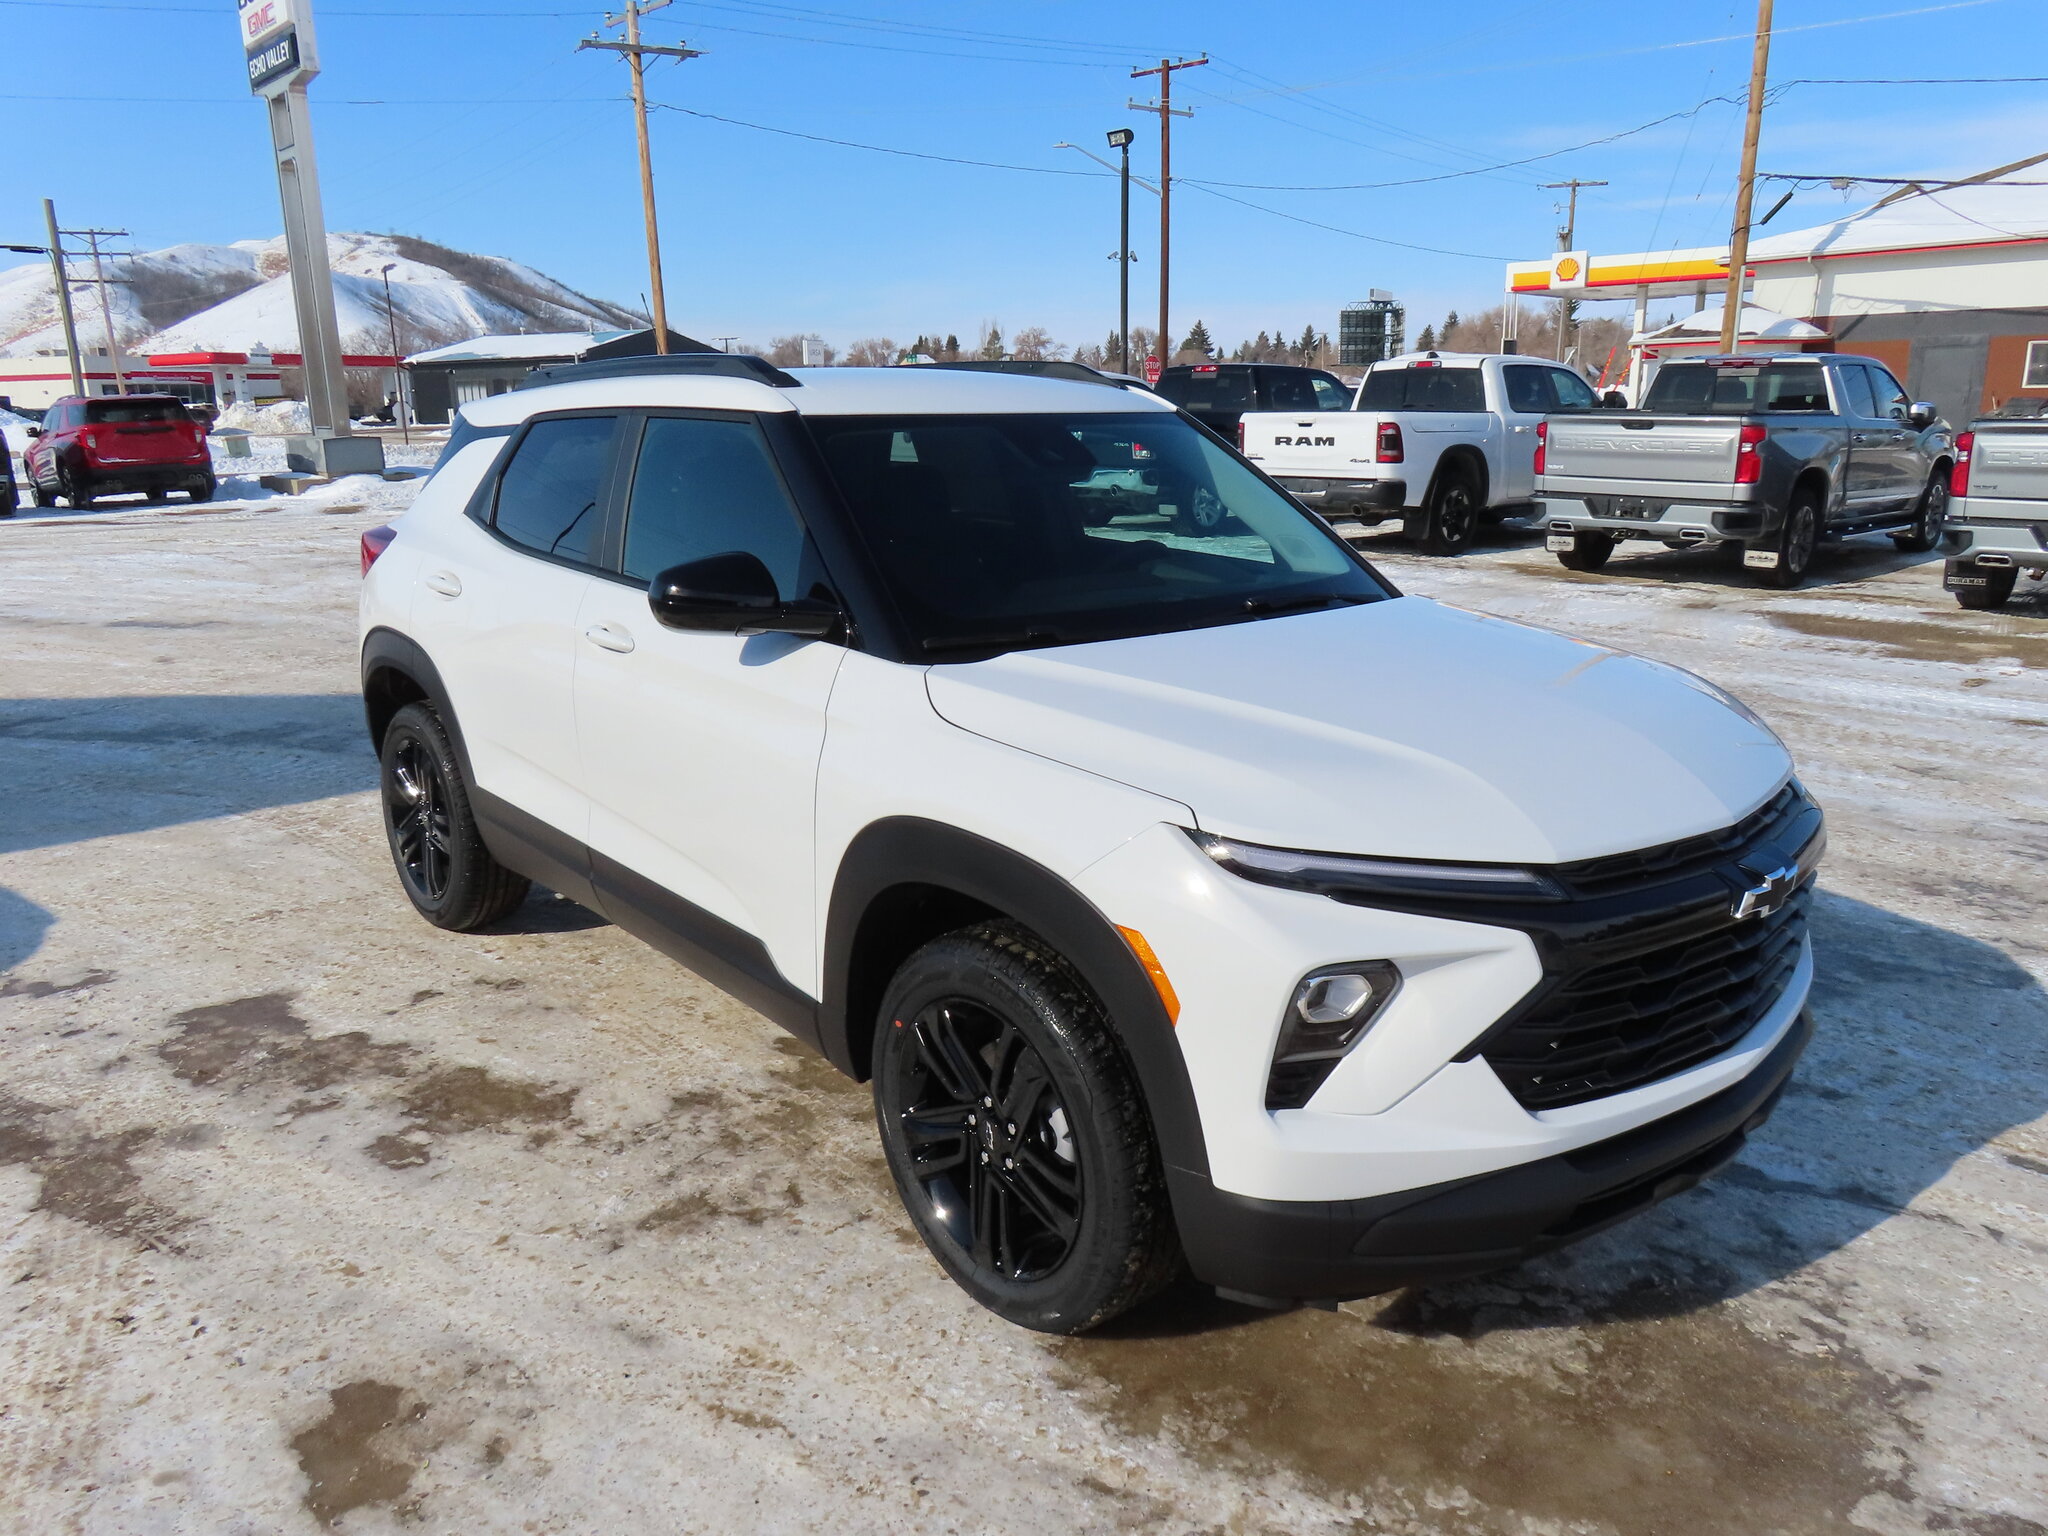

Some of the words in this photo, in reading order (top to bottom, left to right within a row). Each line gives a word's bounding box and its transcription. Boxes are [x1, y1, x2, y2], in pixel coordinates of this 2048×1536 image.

[247, 2, 275, 35] GMC
[249, 54, 266, 79] ECHO
[265, 40, 290, 69] VALLEY
[1145, 361, 1160, 369] STOP
[1275, 436, 1335, 446] RAM
[1555, 437, 1724, 454] CHEVROLET
